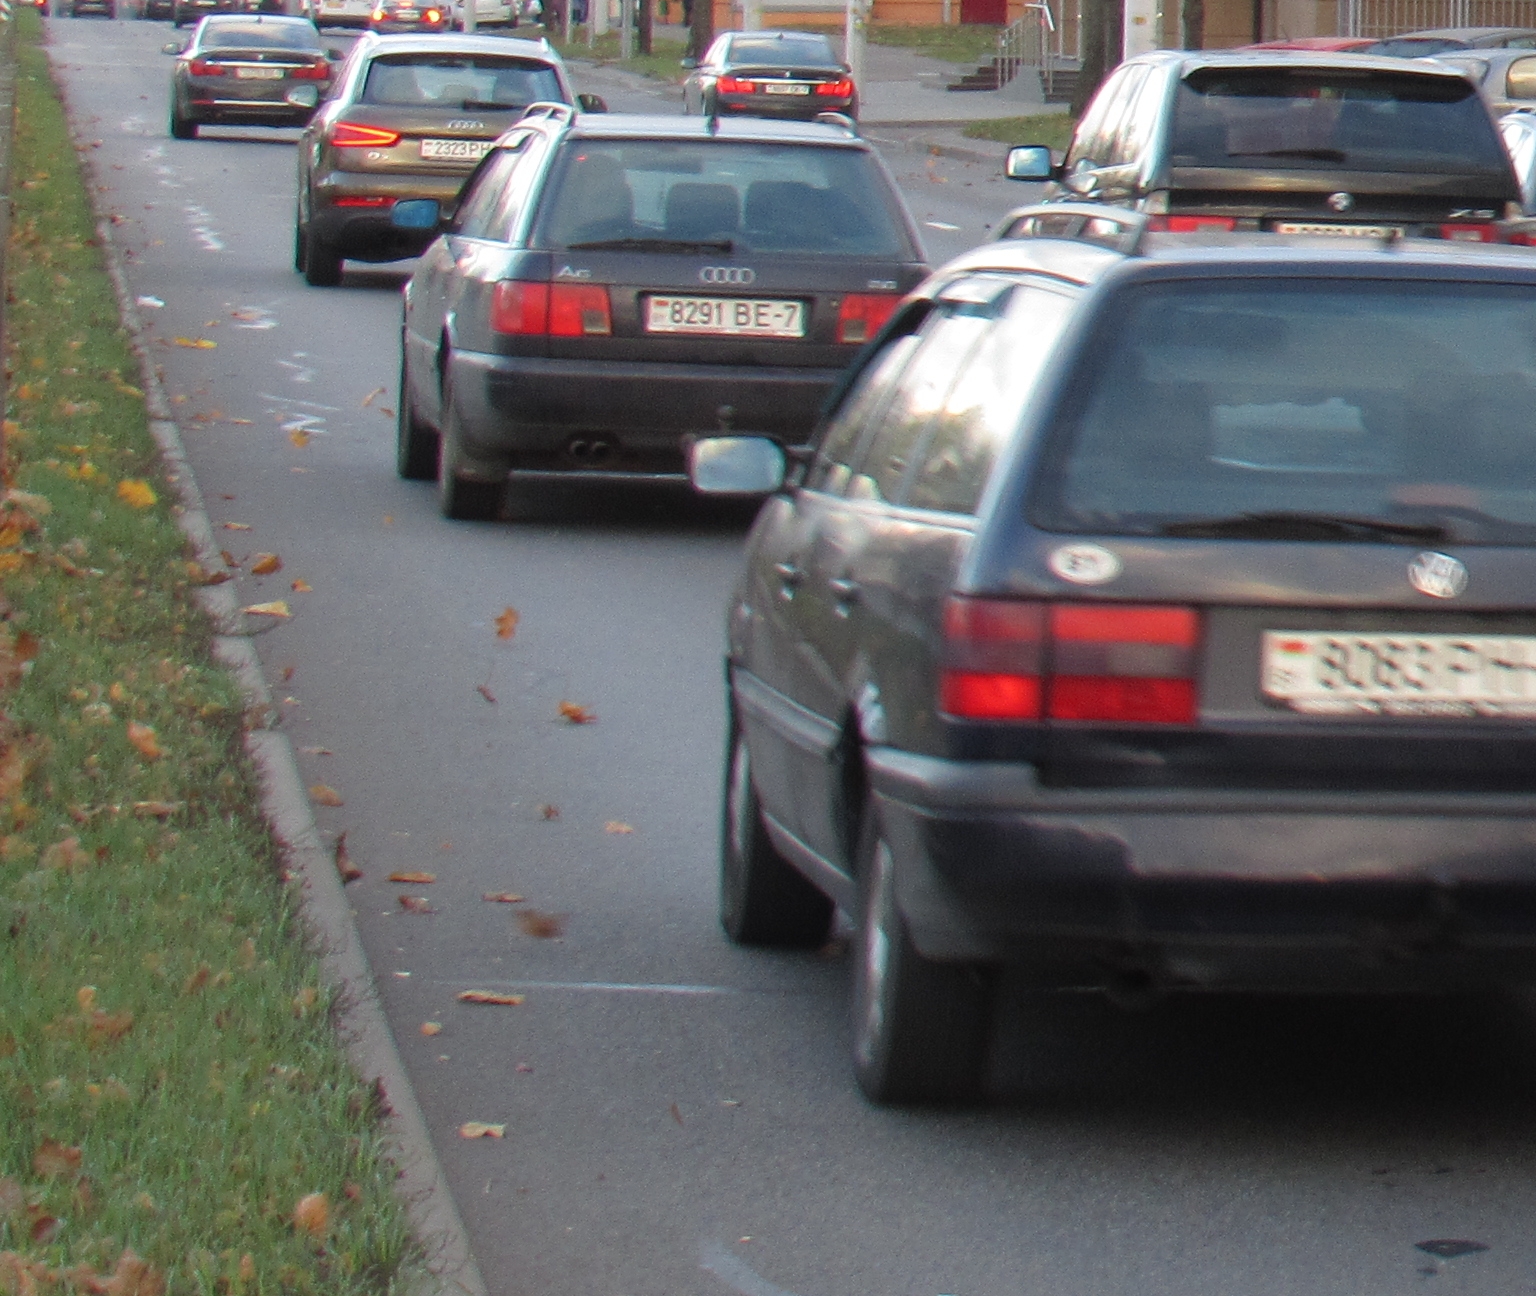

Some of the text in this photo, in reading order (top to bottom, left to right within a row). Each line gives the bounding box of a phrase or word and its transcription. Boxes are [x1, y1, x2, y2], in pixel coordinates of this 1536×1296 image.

[435, 141, 467, 155] 2323
[670, 300, 799, 327] 8291 BE-7
